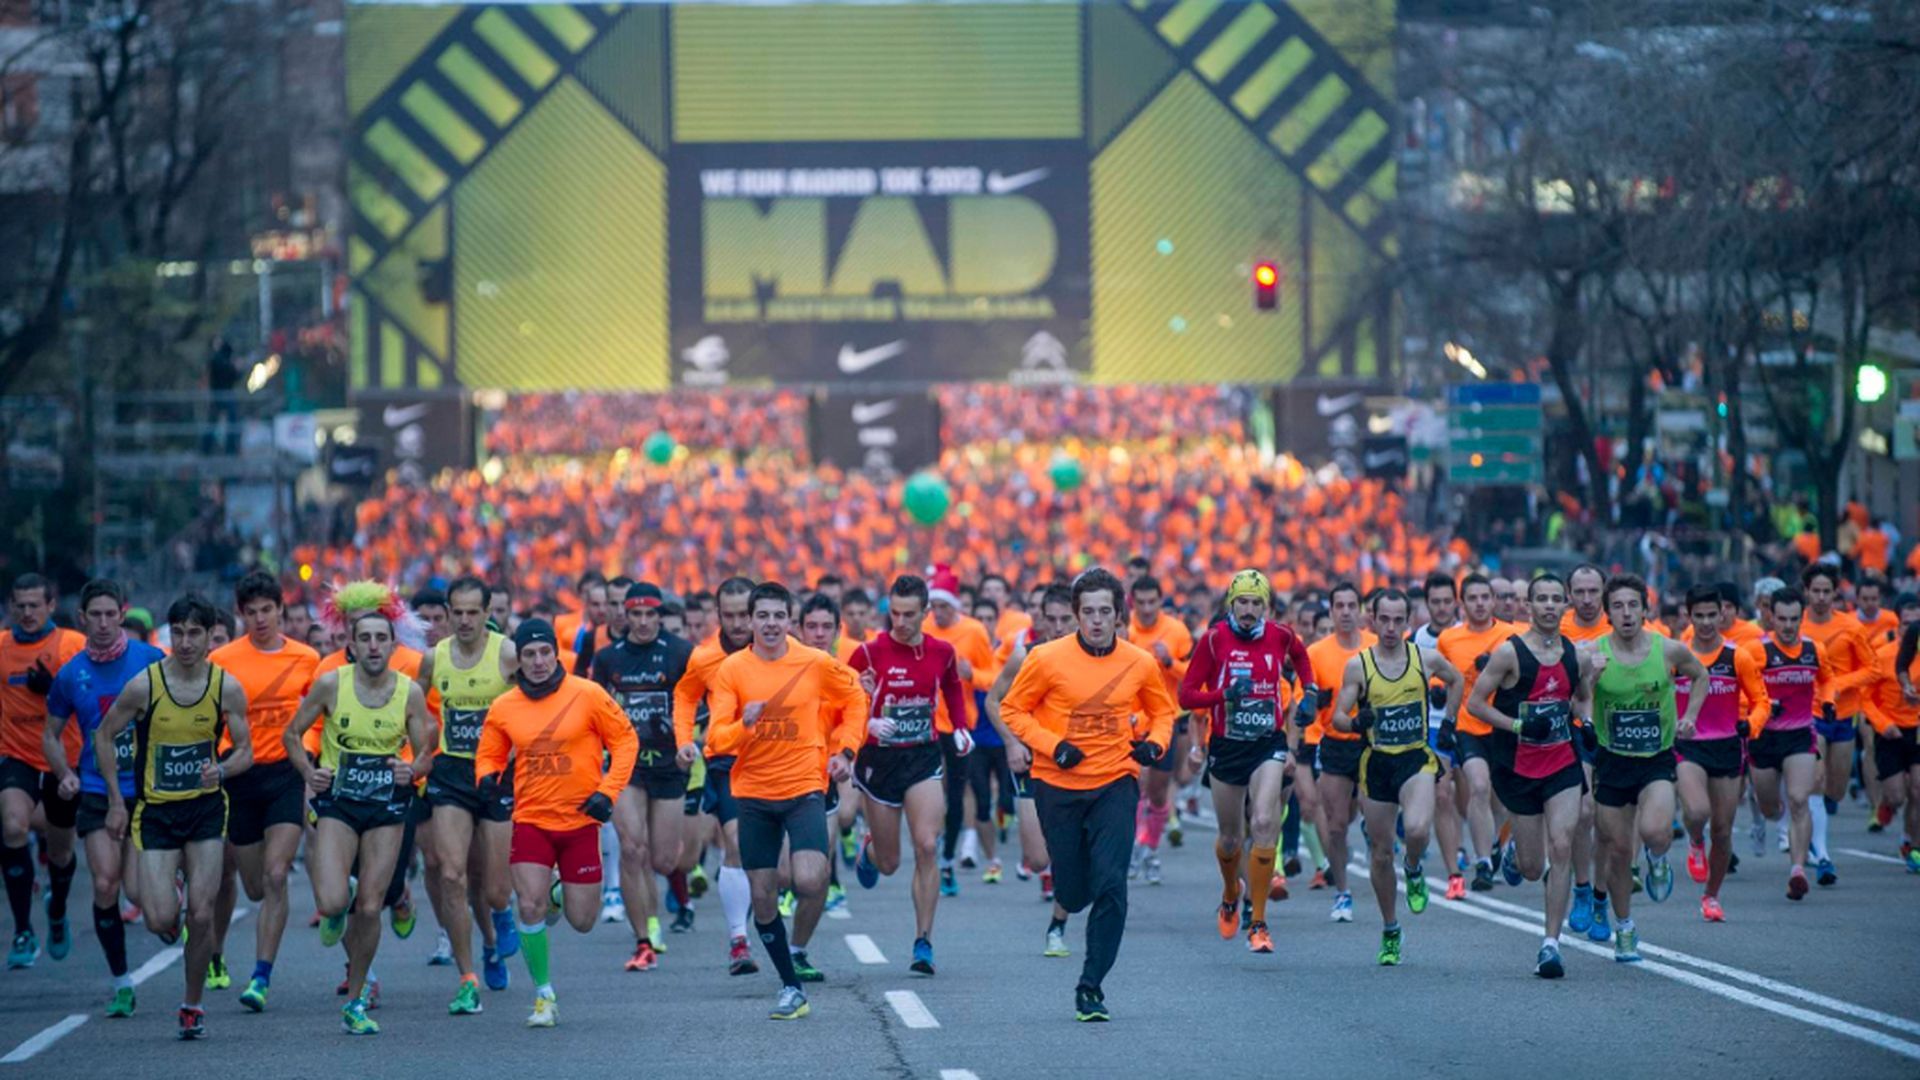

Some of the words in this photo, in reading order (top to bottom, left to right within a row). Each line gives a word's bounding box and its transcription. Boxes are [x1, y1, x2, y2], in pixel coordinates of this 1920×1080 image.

[788, 167, 877, 195] MADRID
[702, 195, 1058, 296] MAD
[1380, 716, 1422, 732] 42002
[1616, 725, 1660, 738] 50050
[347, 768, 393, 785] 50048
